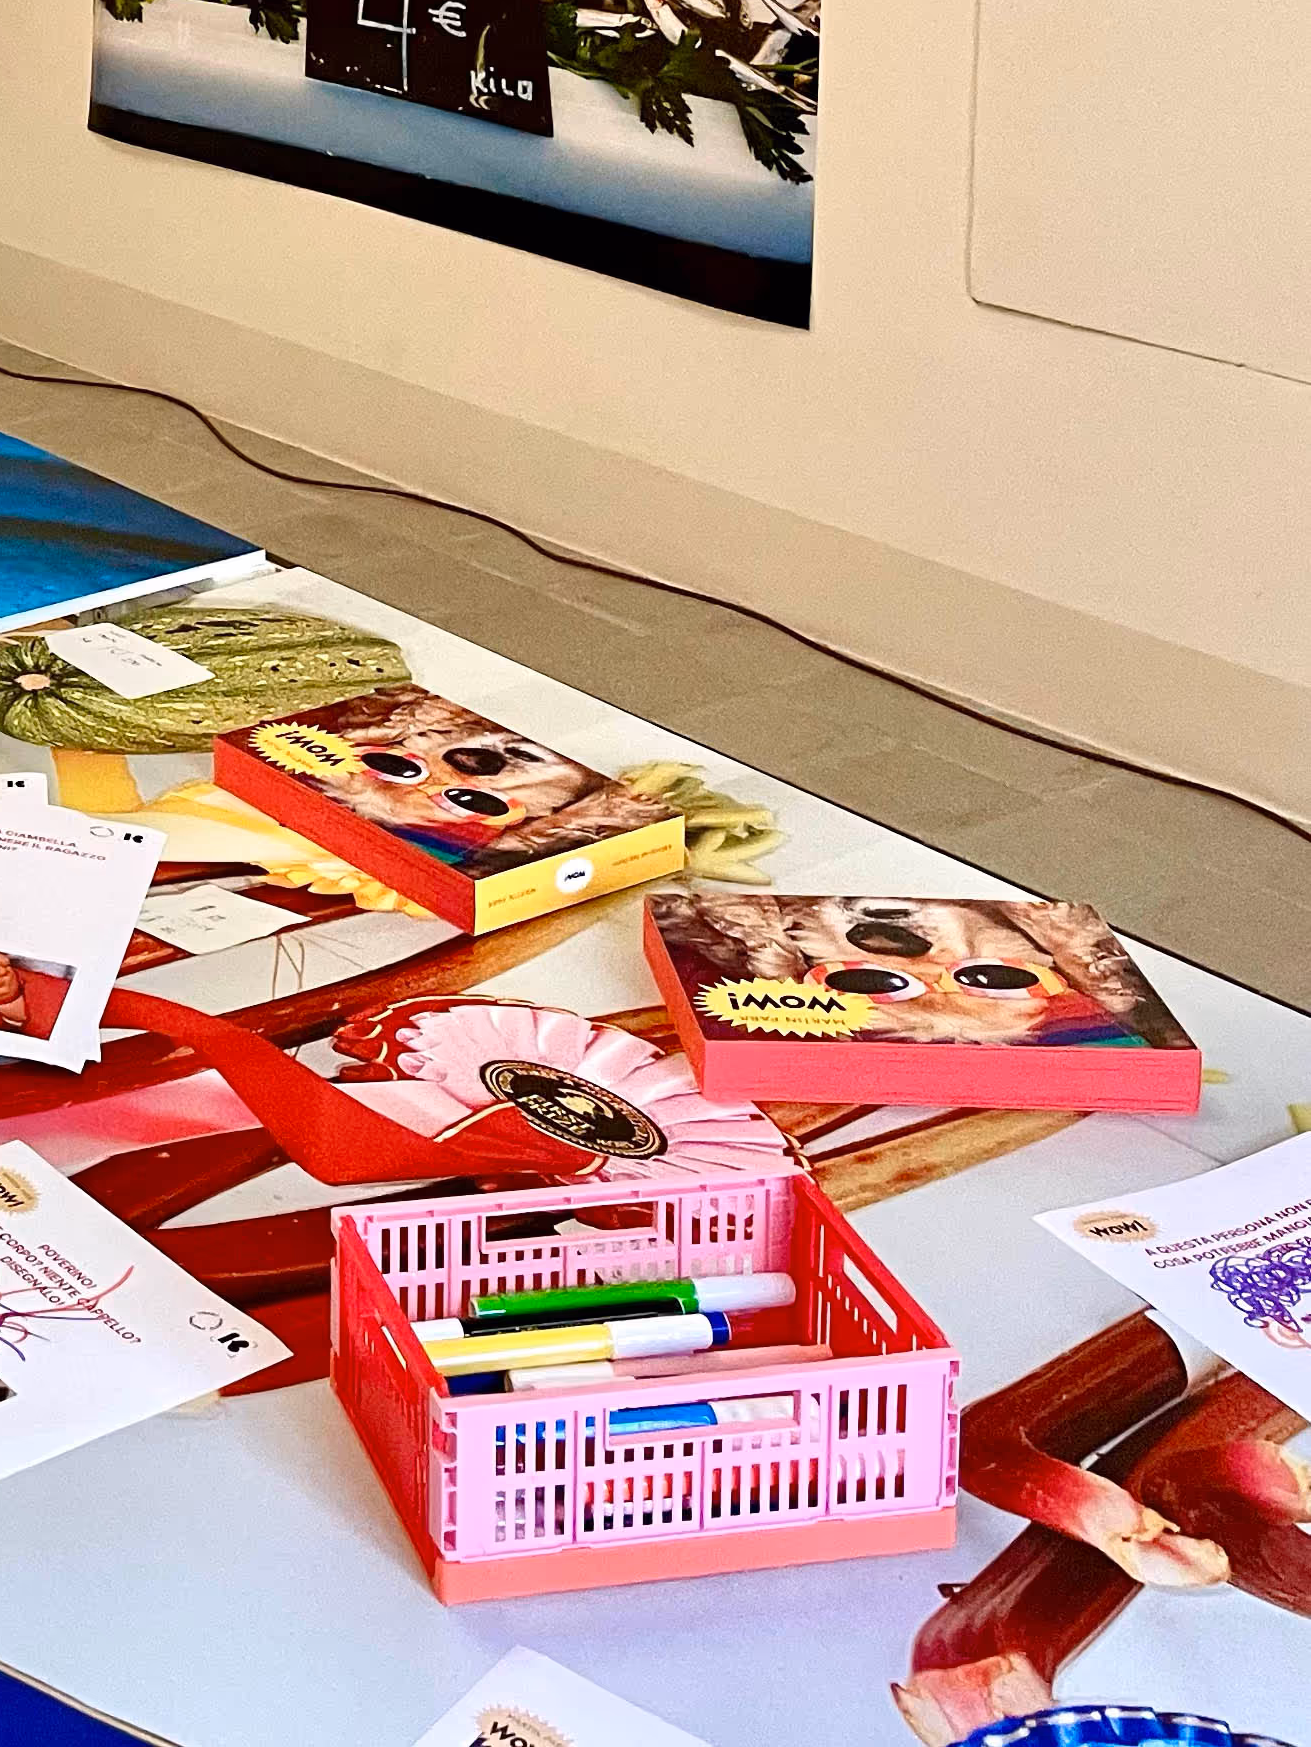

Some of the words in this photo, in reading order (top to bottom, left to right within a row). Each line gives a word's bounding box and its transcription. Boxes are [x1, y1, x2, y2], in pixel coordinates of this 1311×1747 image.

[274, 730, 347, 767] WOW!
[727, 992, 847, 1014] WOW!
[1088, 1219, 1149, 1238] WOW!
[1155, 1236, 1214, 1254] QUESTA
[1210, 1216, 1278, 1242] PERSONA
[1274, 1202, 1309, 1220] NON
[37, 1244, 98, 1290] POVERINO!
[1153, 1256, 1196, 1269] COSA
[1192, 1237, 1266, 1262] POTREBBE
[0, 1232, 44, 1267] CORPO?
[38, 1266, 82, 1299] NIENTE
[77, 1297, 142, 1344] CAPPELLO?
[489, 1720, 535, 1747] WO
